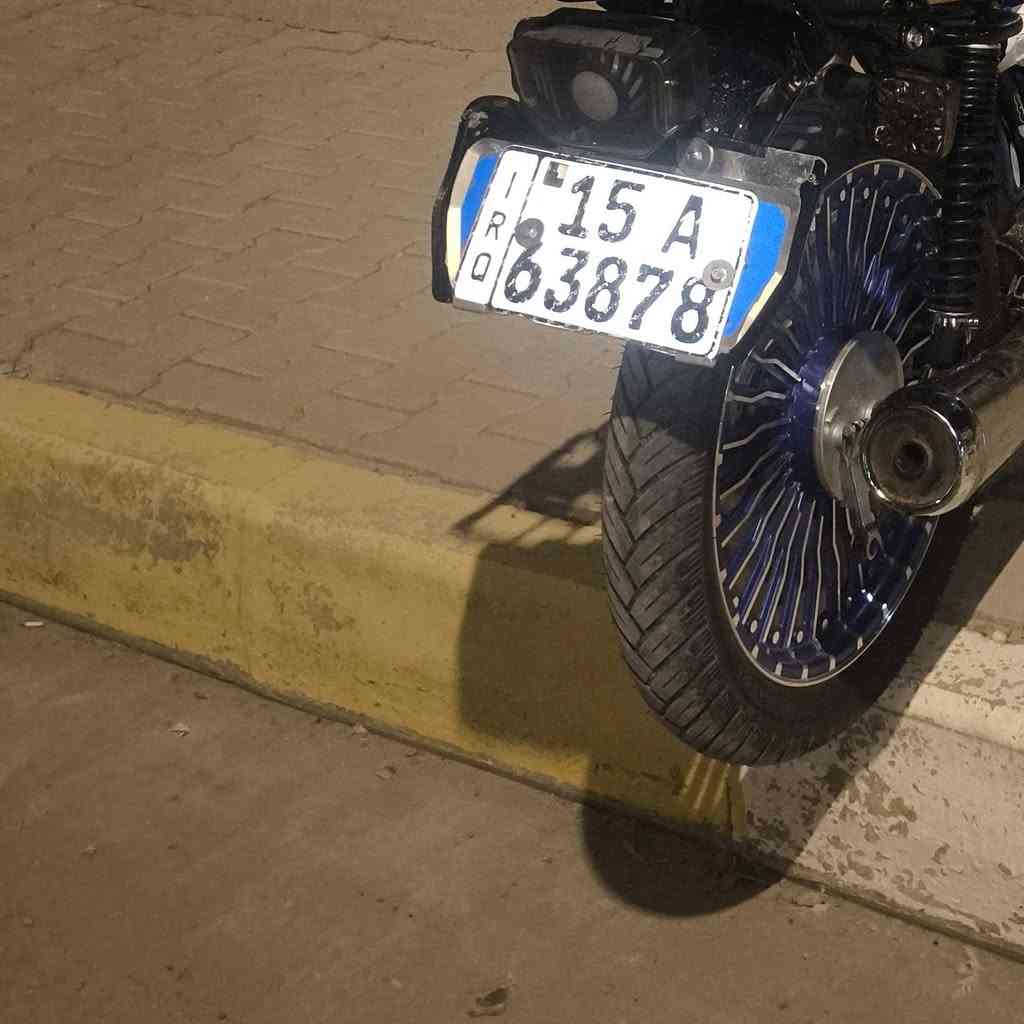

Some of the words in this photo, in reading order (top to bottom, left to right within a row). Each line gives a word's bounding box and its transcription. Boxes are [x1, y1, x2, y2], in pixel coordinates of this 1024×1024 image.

[558, 175, 646, 243] 15
[661, 195, 704, 259] A
[503, 247, 716, 344] 63878
